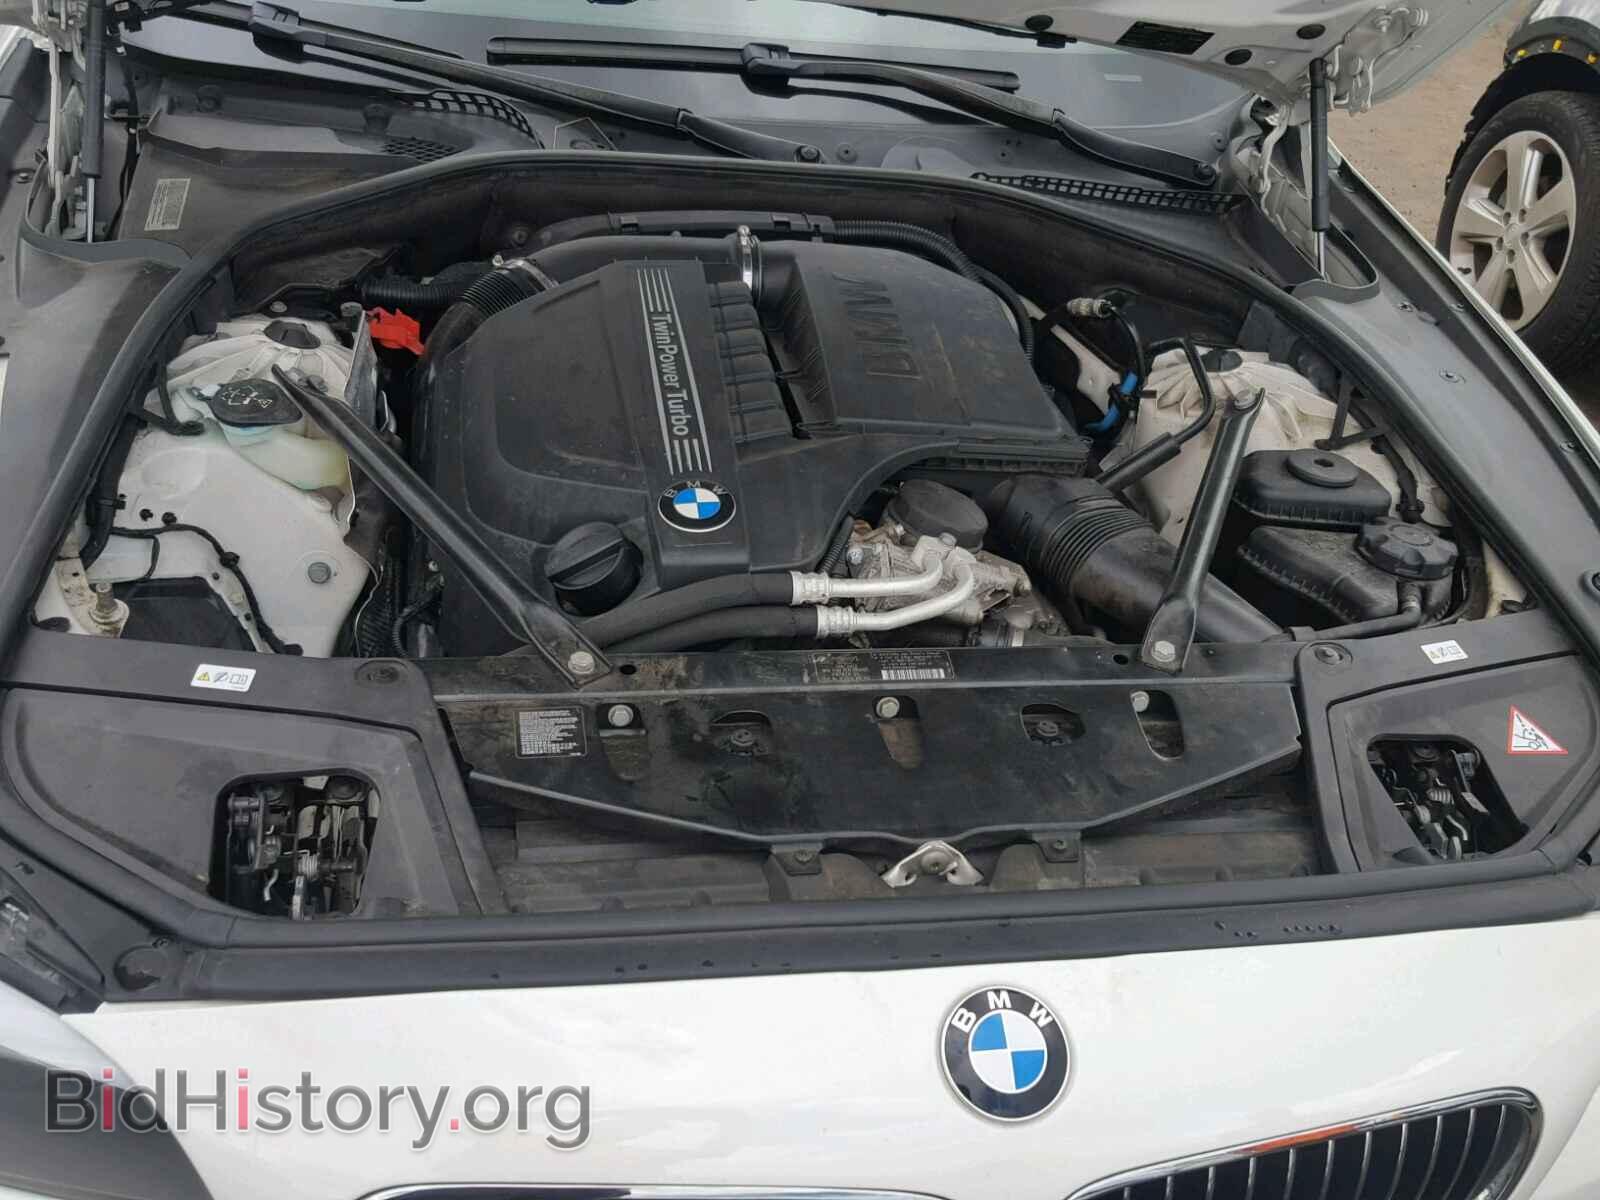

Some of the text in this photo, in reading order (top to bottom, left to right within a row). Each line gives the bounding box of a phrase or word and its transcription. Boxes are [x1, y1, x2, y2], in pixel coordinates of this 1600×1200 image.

[651, 313, 692, 436] TwinPower Turbo
[663, 480, 729, 498] BMW
[950, 990, 1053, 1034] BMW
